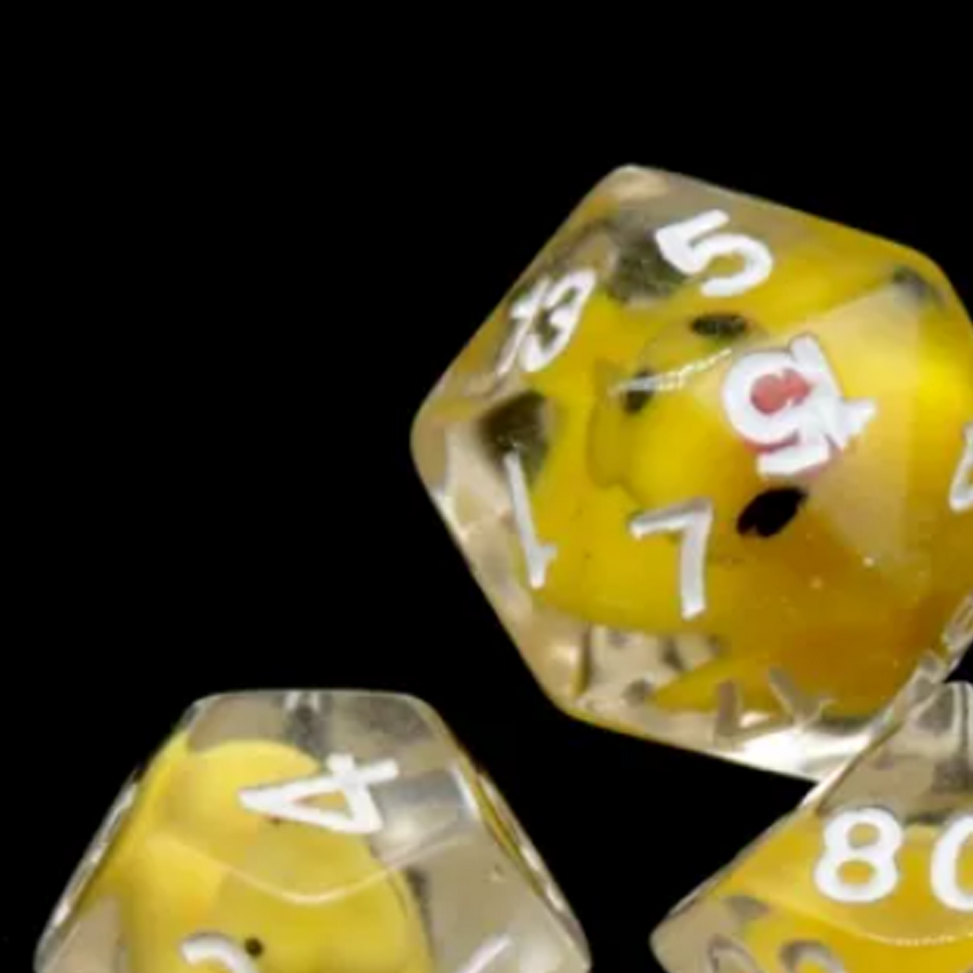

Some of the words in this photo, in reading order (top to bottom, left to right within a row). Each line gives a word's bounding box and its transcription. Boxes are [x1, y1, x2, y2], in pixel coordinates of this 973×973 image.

[654, 209, 773, 296] 5
[503, 445, 558, 588] 1
[628, 497, 714, 620] 7
[236, 752, 400, 835] 4
